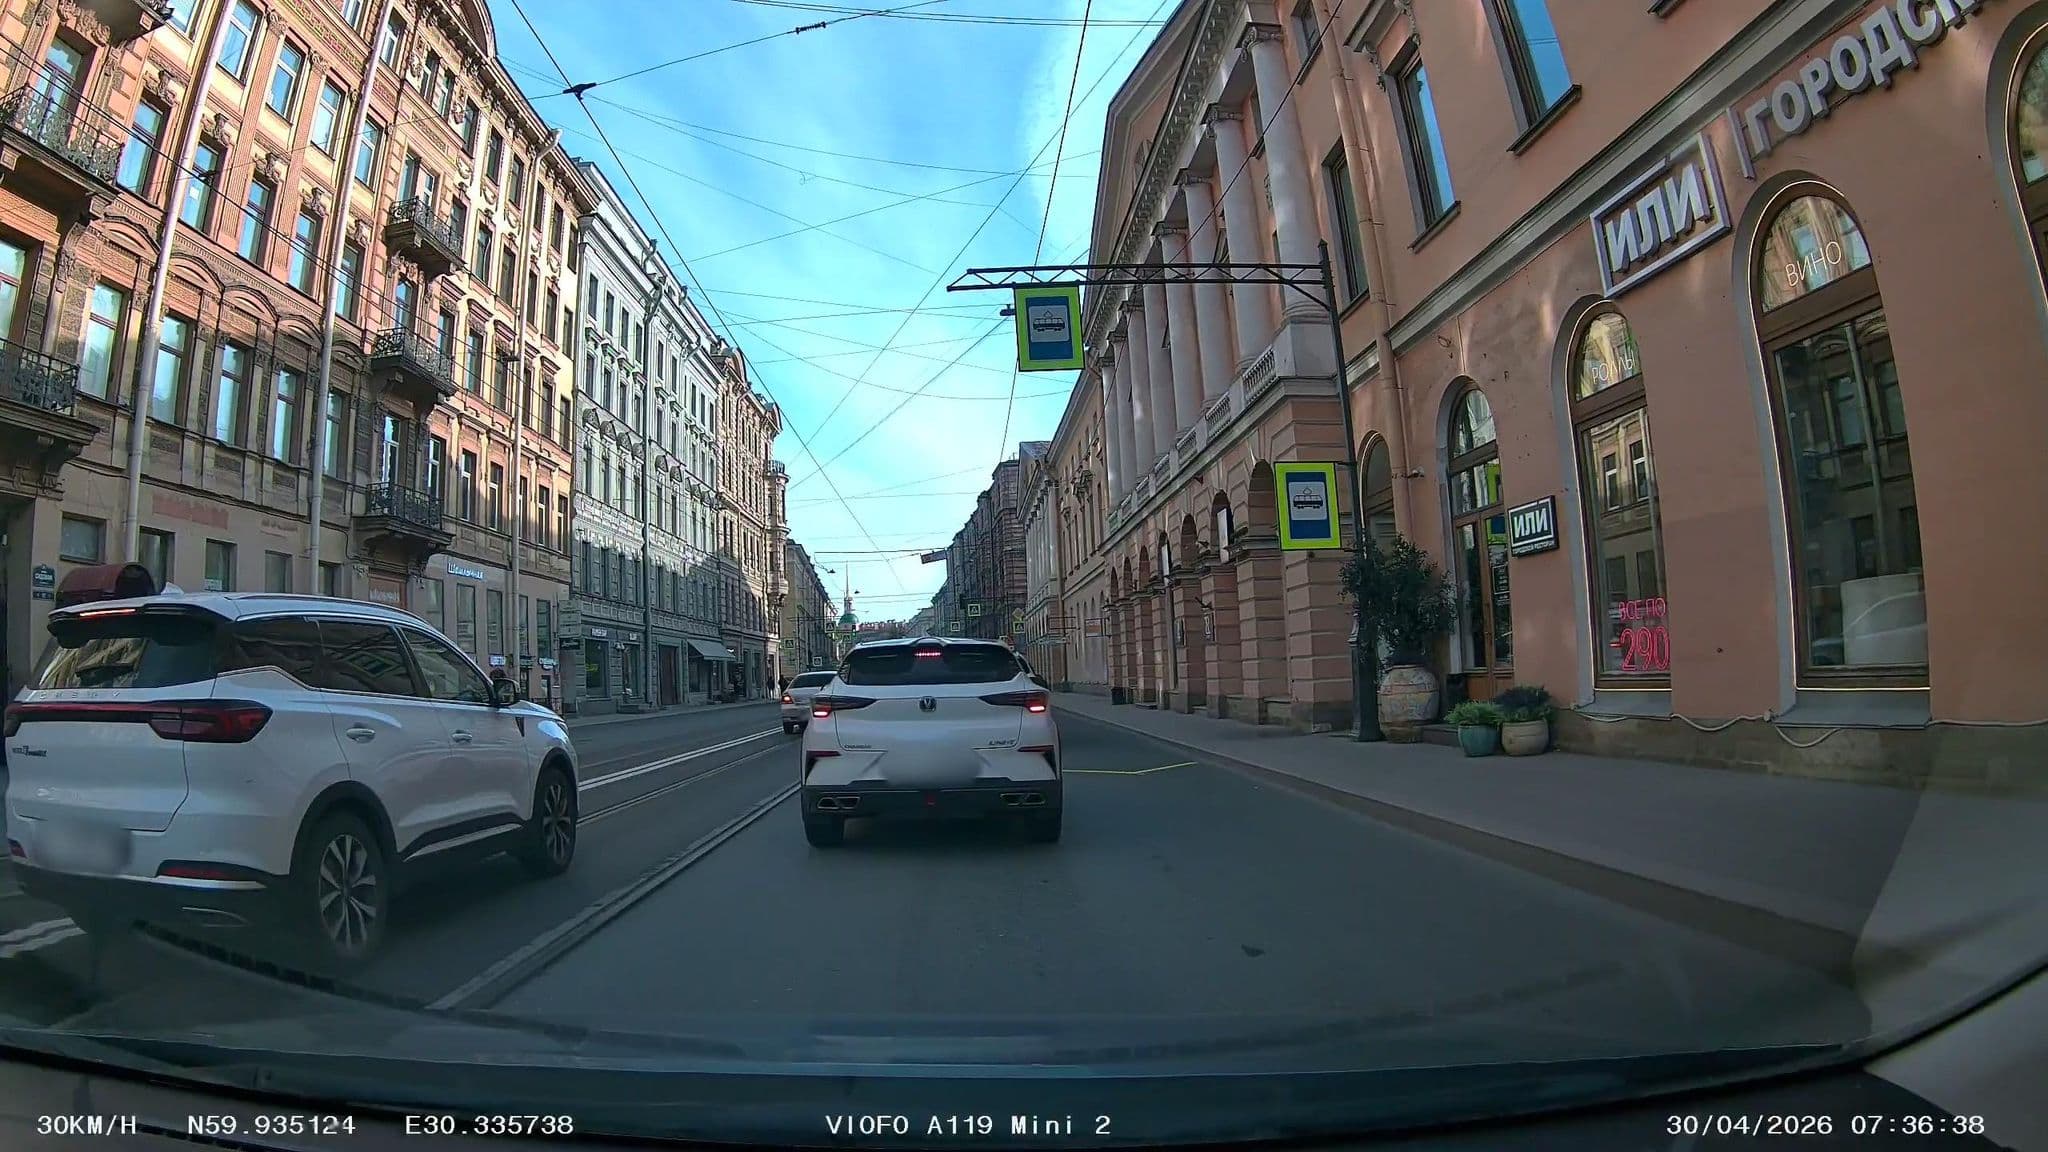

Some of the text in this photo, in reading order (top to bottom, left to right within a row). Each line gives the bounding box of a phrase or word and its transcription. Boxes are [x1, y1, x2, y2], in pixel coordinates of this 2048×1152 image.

[1604, 163, 1709, 273] ИЛИ
[1785, 241, 1842, 287] ВИНО
[1513, 507, 1548, 538] ИЛИ
[1619, 597, 1666, 620] ВСЕ ПО
[1609, 626, 1670, 671] -290
